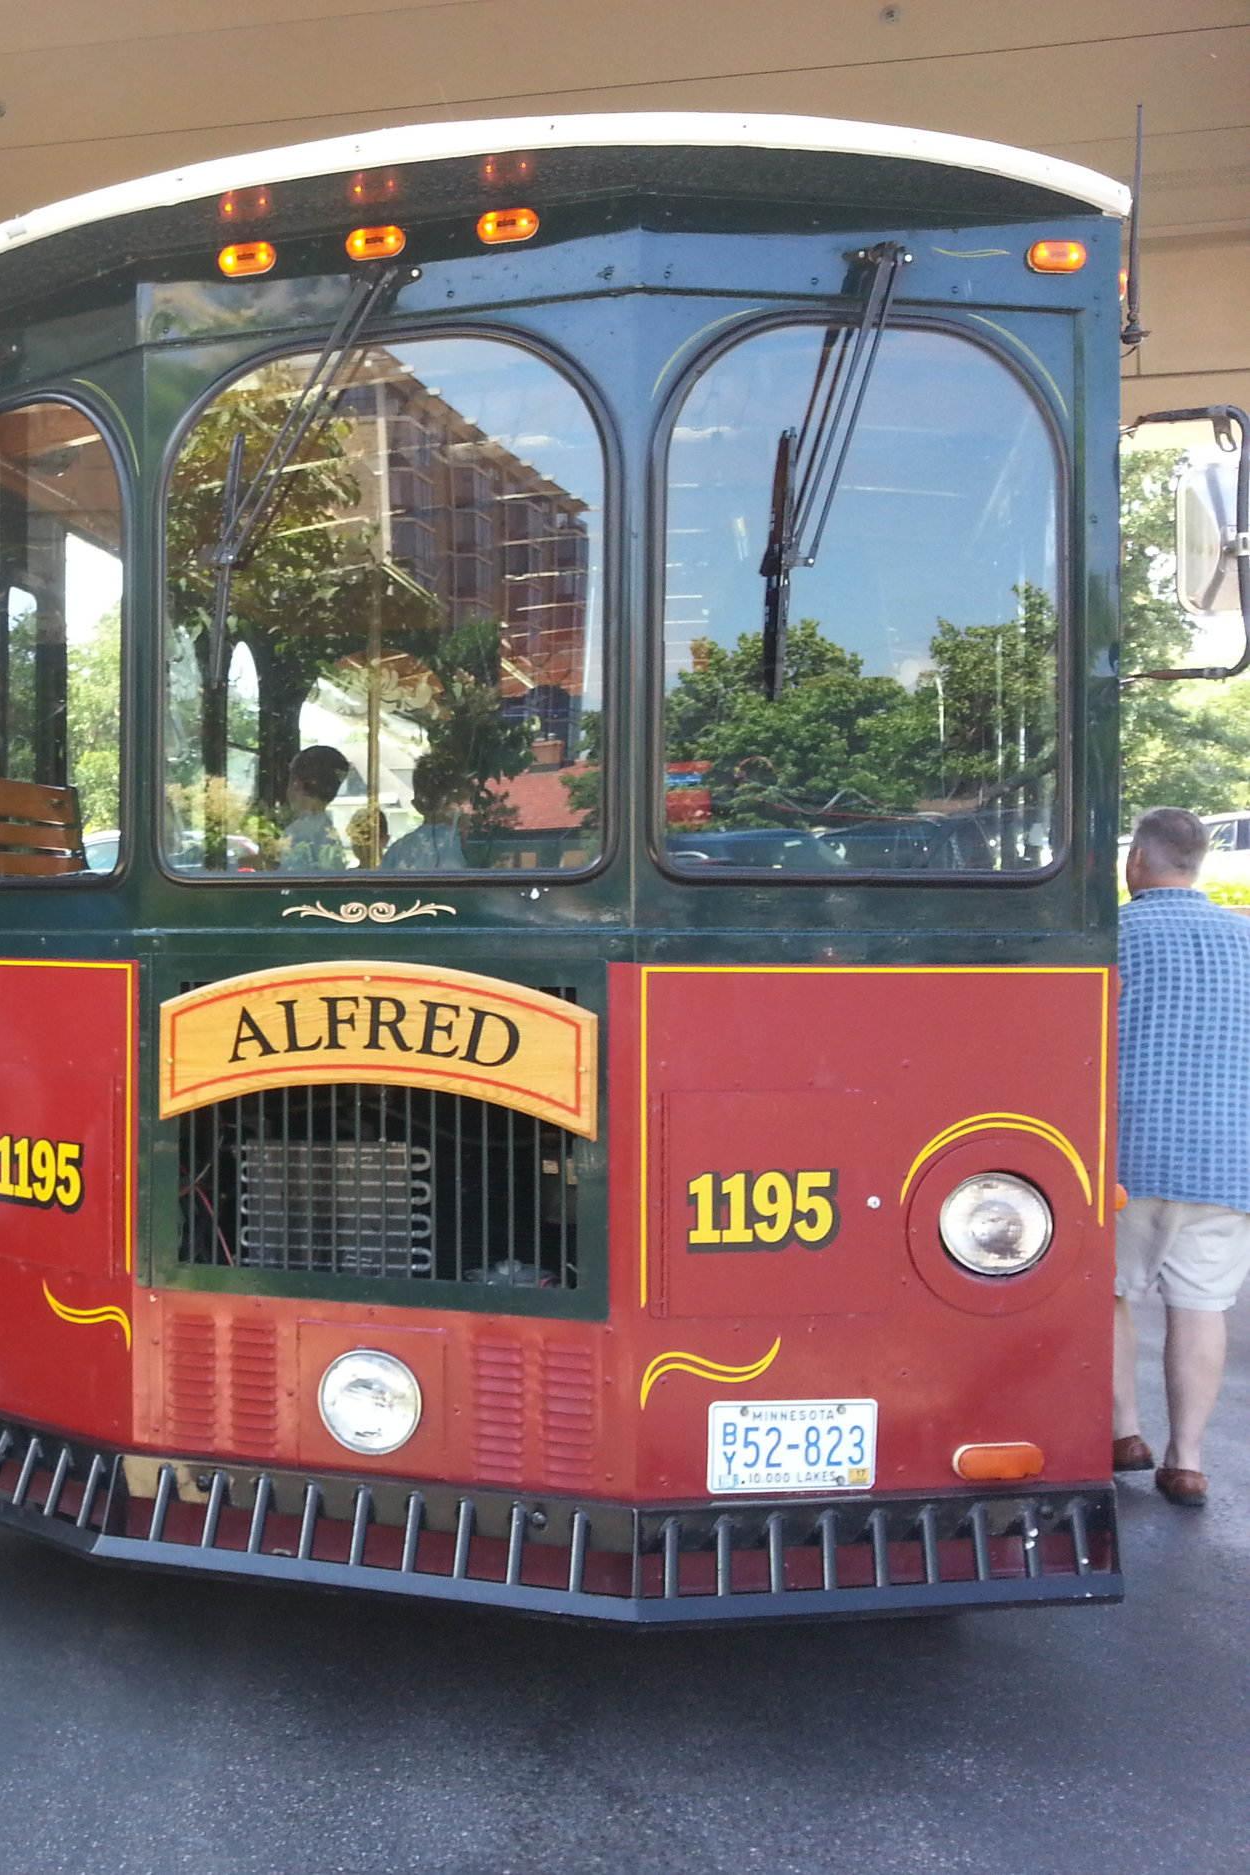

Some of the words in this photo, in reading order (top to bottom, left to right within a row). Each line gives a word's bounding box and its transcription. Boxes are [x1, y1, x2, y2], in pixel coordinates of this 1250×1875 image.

[227, 996, 521, 1068] ALFRED
[688, 1170, 837, 1247] 1195
[752, 1410, 835, 1421] MINNESOTA
[743, 1425, 865, 1468] 52-823
[797, 1471, 837, 1482] LAKES
